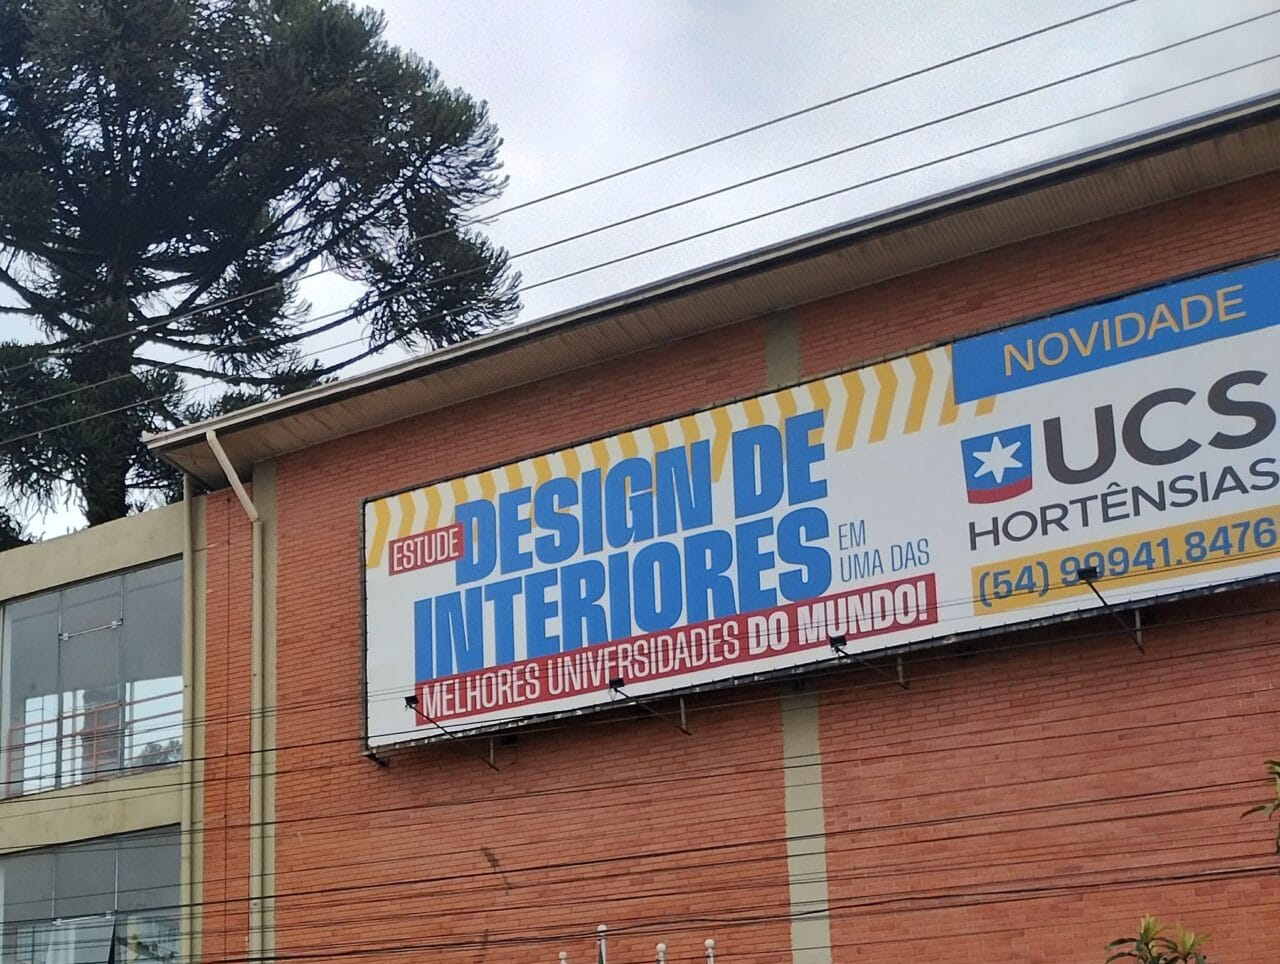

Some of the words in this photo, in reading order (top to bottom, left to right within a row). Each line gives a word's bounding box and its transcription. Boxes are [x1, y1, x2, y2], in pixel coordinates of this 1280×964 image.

[1003, 284, 1247, 376] NOVIDADE
[1042, 369, 1277, 485] UCS
[455, 439, 711, 586] DESIGN
[732, 409, 828, 518] DE
[838, 520, 866, 550] EM
[969, 457, 1280, 551] HORTÊNSIAS
[392, 528, 459, 573] ESTUDE
[414, 506, 832, 681] INTERIORES
[839, 553, 884, 583] UMA
[891, 538, 930, 572] DAS
[978, 560, 1049, 608] (54)
[1060, 517, 1277, 586] 99941.8476
[421, 664, 541, 720] MELHORES
[548, 621, 740, 695] UNIVERSIDADES
[748, 611, 790, 652] DO
[797, 582, 928, 644] MUNDO!
